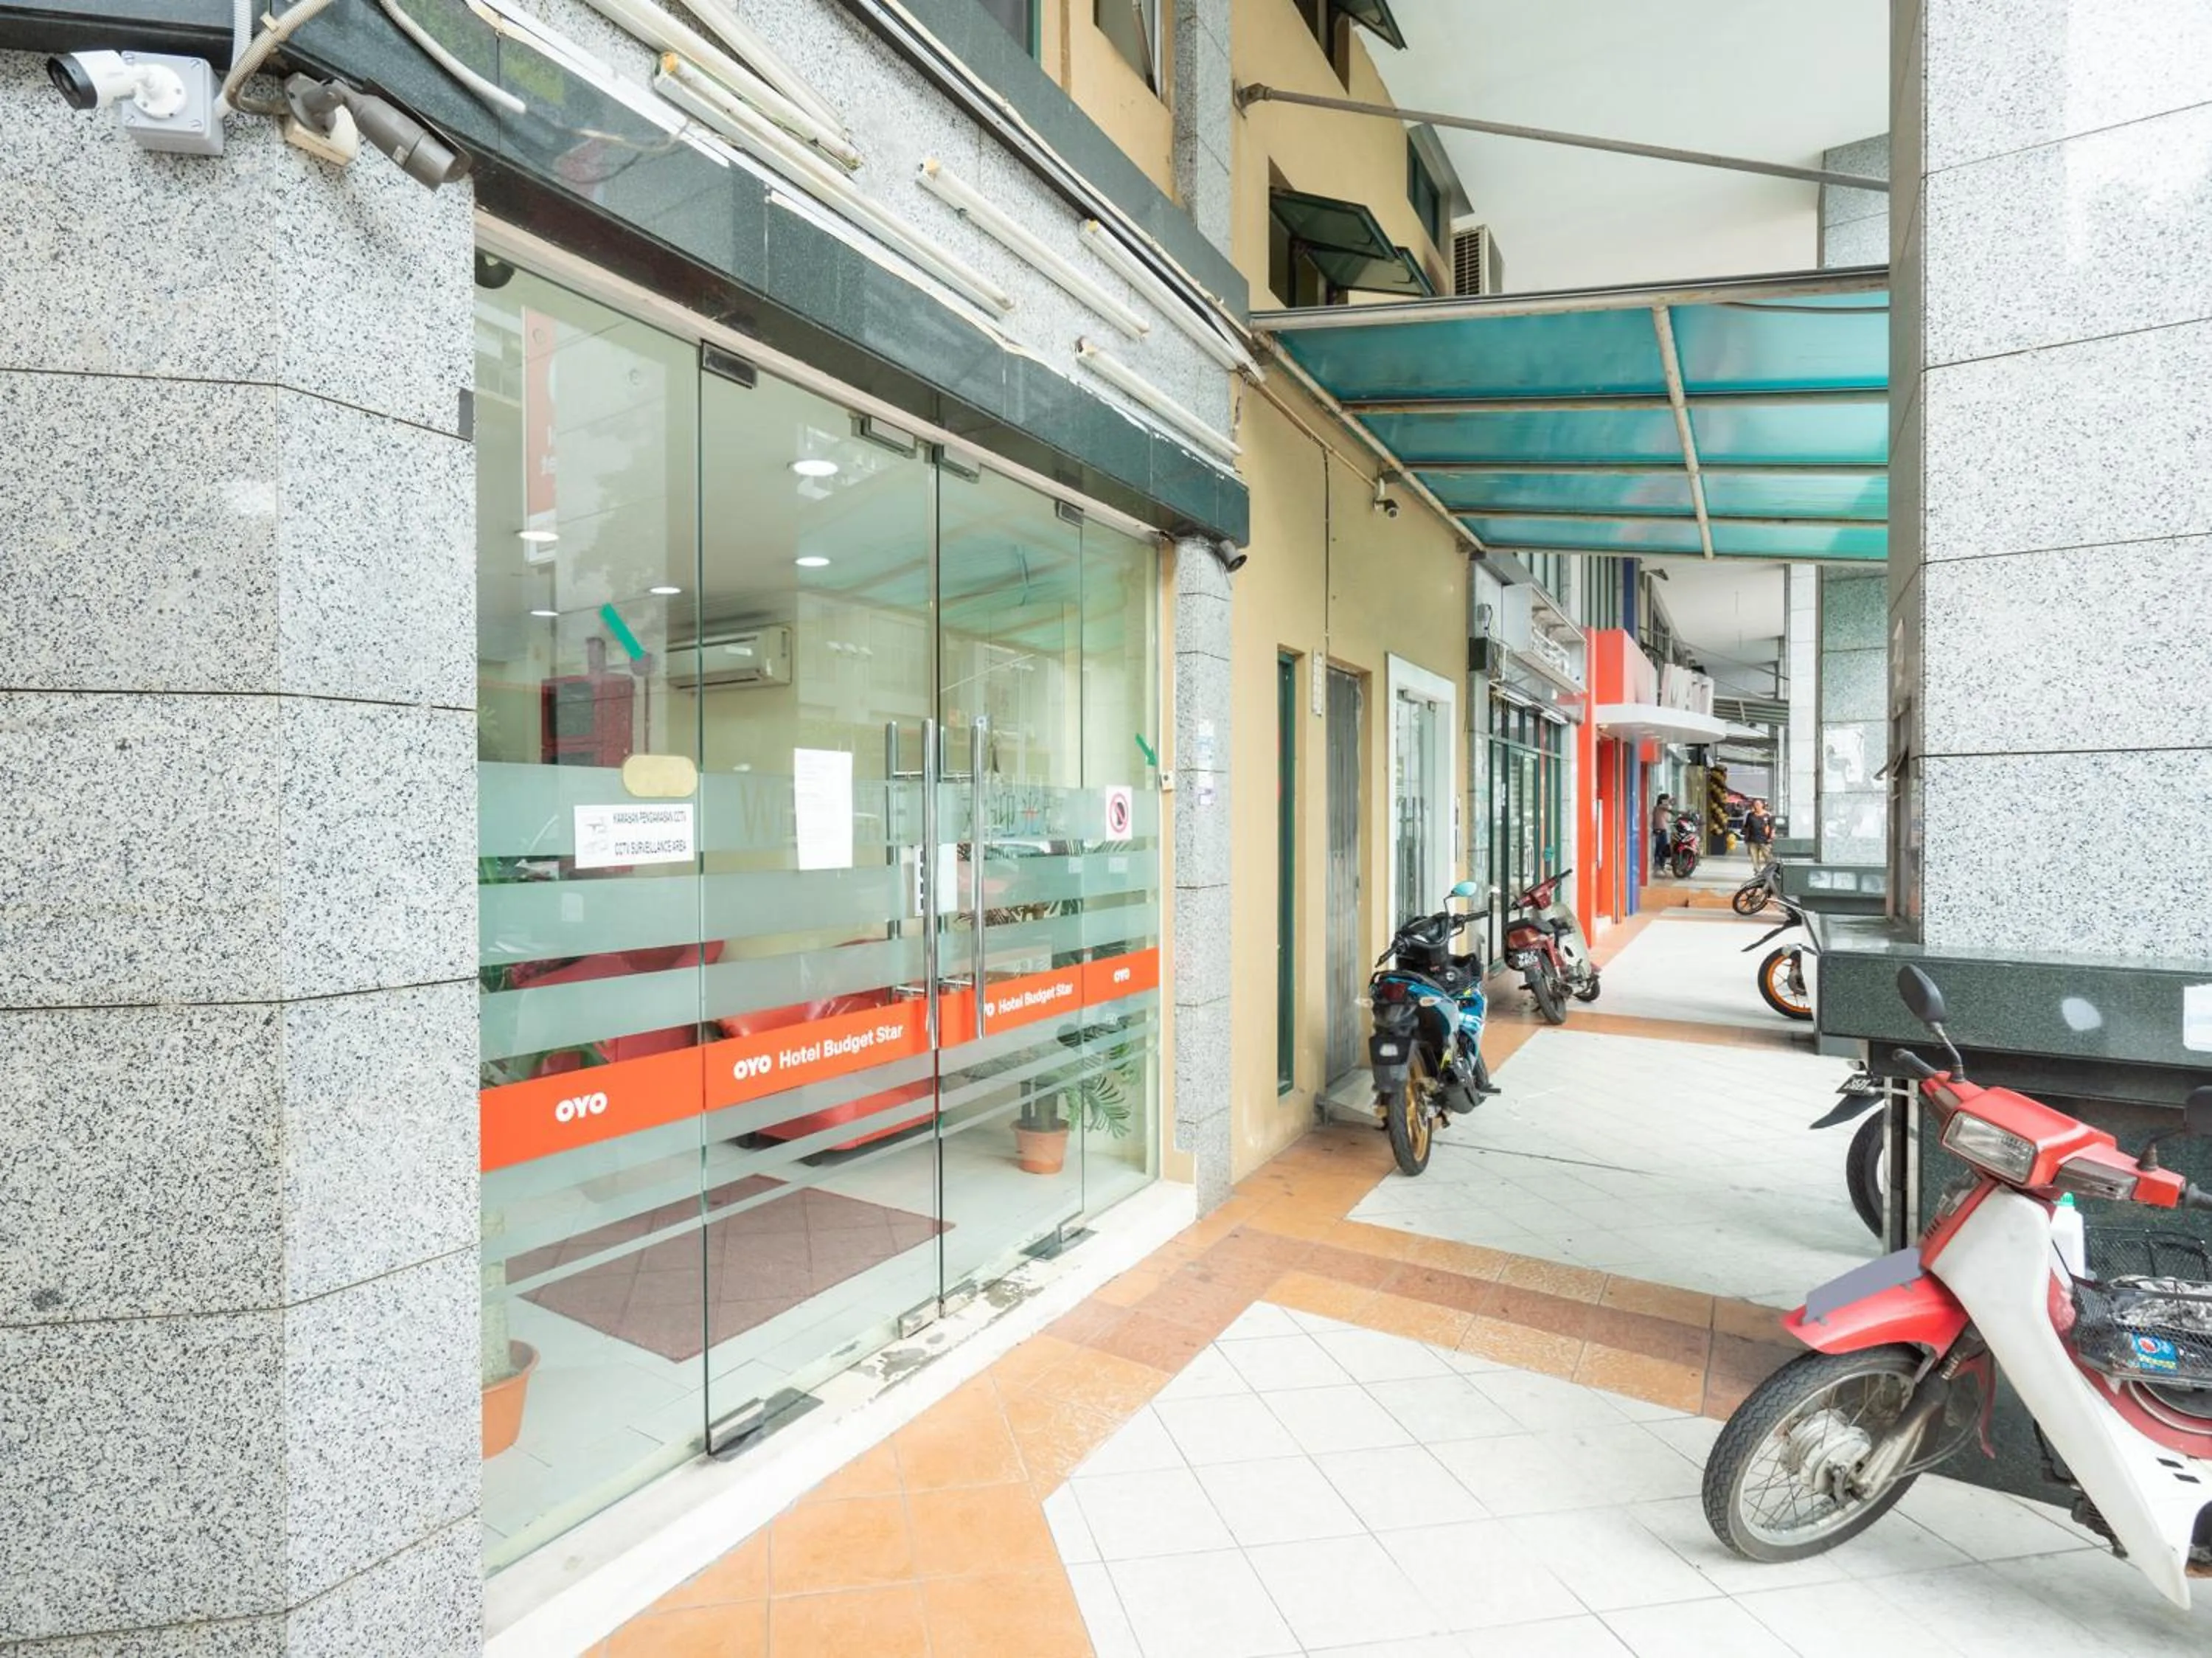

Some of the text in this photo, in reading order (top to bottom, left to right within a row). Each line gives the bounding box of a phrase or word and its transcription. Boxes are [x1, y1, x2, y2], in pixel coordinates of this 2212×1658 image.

[615, 842, 630, 855] CCTV
[672, 839, 686, 852] AREA
[1113, 968, 1130, 982] OYO
[998, 993, 1023, 1015] Hotel
[1024, 985, 1055, 1005] Budget
[1055, 982, 1074, 997] Star
[733, 1025, 903, 1080] OYO Hotel Budget Star
[554, 1092, 608, 1123] OYO
